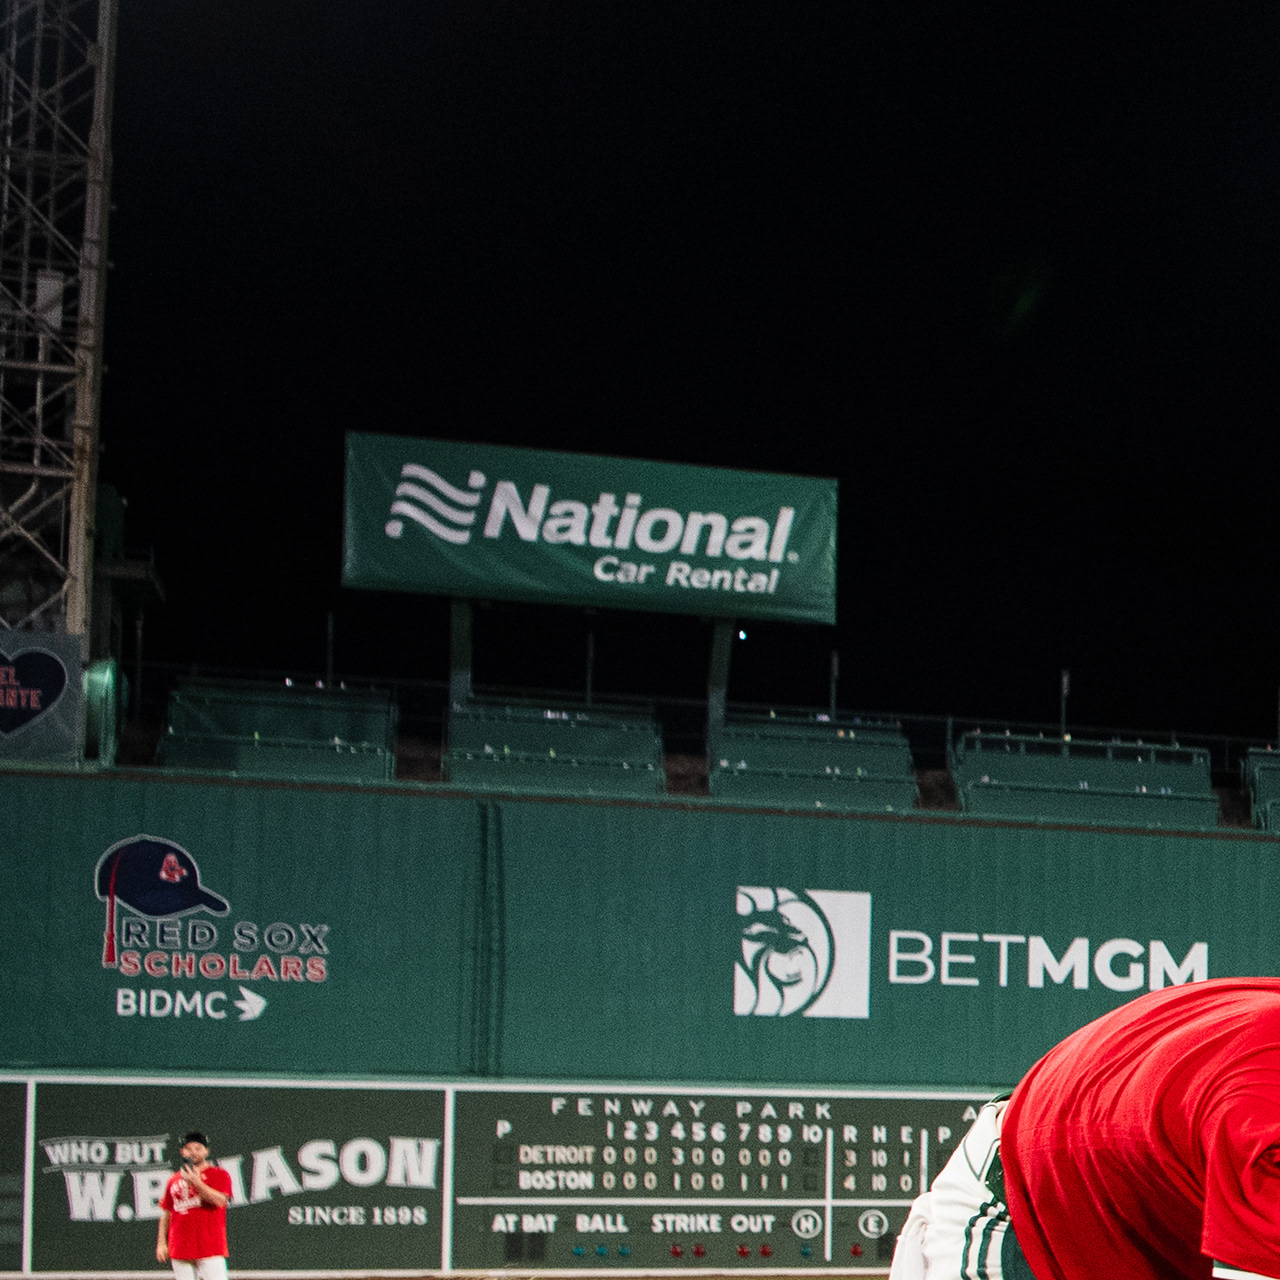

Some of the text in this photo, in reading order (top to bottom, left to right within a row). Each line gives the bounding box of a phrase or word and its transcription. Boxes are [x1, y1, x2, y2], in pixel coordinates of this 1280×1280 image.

[484, 481, 795, 563] National
[593, 556, 779, 594] Car Rental
[121, 917, 330, 954] RED SOX
[119, 950, 328, 983] SCHOLARS
[889, 930, 1208, 992] BETMGM
[116, 988, 228, 1020] BIDMC
[551, 1097, 832, 1120] FENWAY PARK
[496, 1120, 913, 1144] P 1 2 3 4 5 6 7 8 9 10 R H E
[938, 1126, 951, 1144] P
[44, 1139, 167, 1165] WHO BUT
[519, 1145, 596, 1165] DETROIT
[872, 1151, 887, 1168] 10
[518, 1170, 594, 1190] BOSTON
[872, 1174, 887, 1192] 10
[288, 1206, 428, 1226] SINCE 1898
[492, 1214, 776, 1233] AT BAT BALL STRIKE OUT
